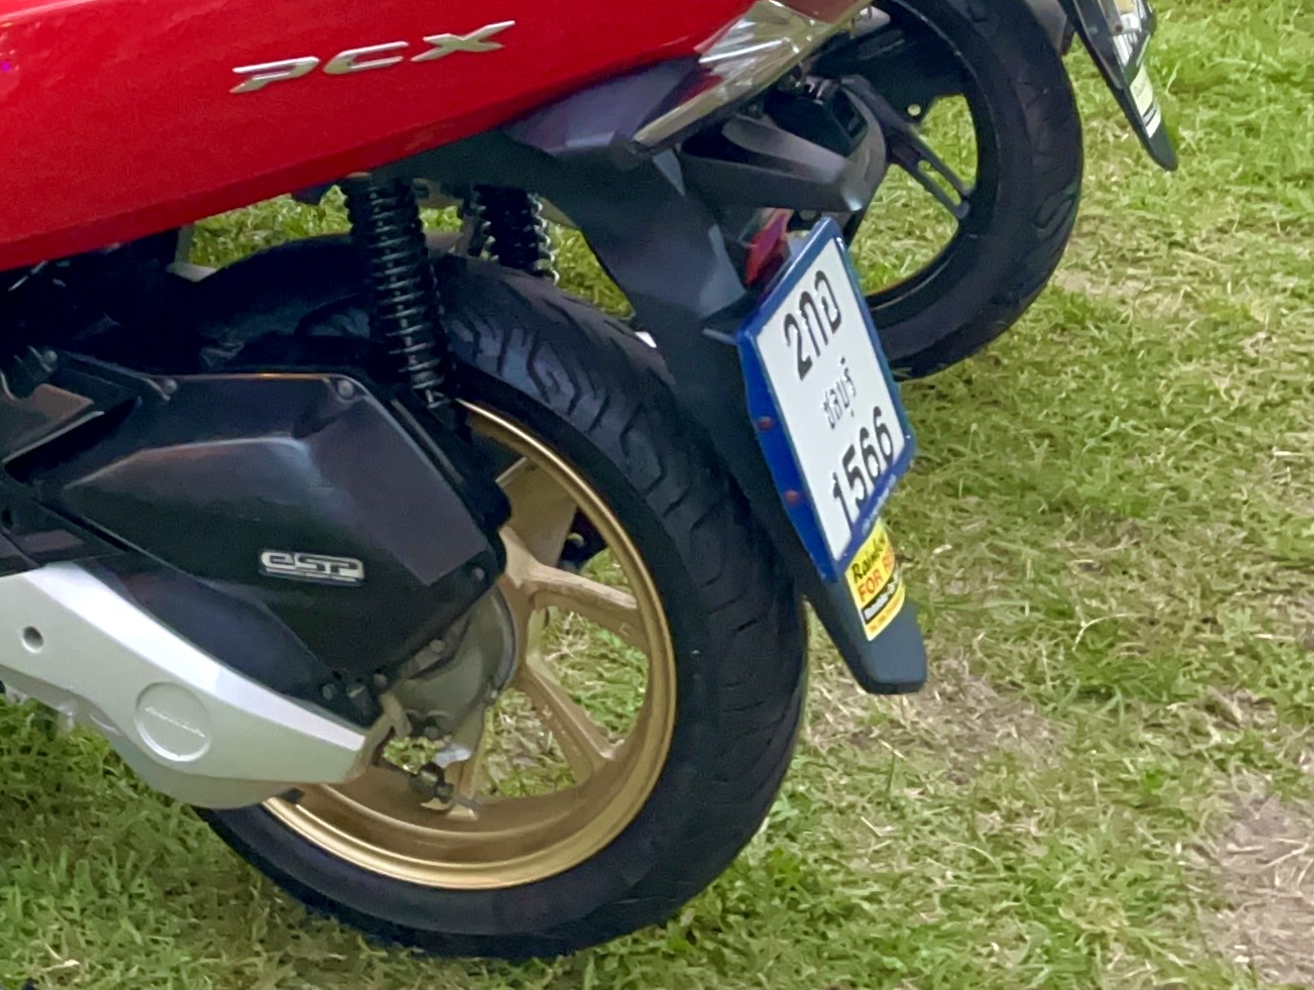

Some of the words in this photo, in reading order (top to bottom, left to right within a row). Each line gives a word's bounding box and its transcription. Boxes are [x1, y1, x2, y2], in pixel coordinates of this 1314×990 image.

[229, 20, 516, 93] PCX
[783, 269, 842, 381] 2กอ
[832, 406, 895, 534] 1566
[857, 568, 884, 603] FOR
